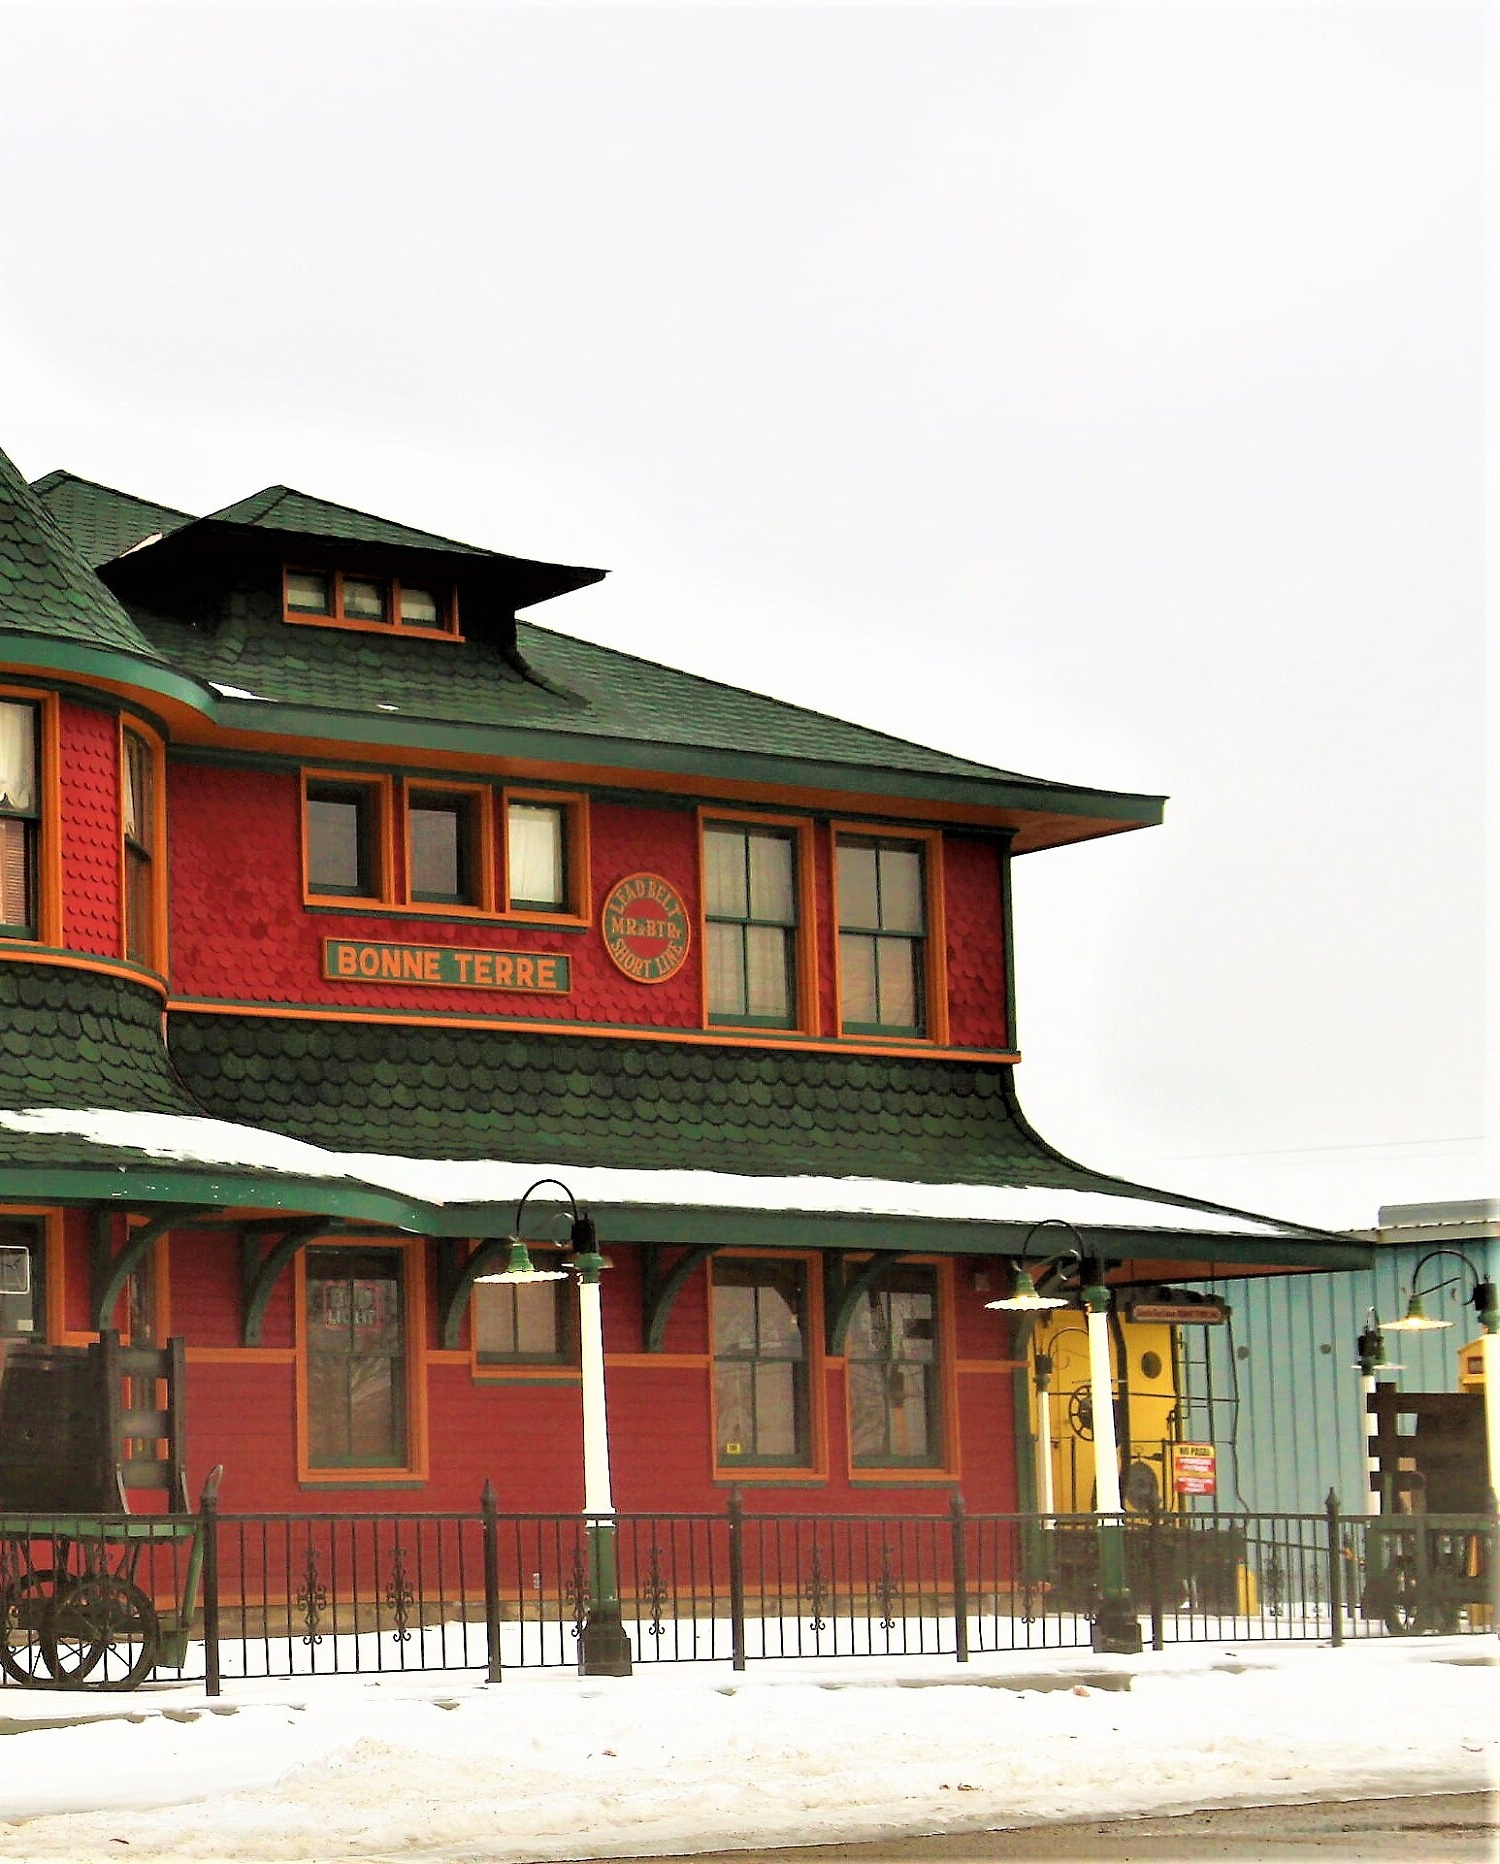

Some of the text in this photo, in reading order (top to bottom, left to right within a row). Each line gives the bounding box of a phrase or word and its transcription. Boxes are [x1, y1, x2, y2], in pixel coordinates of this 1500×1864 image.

[610, 880, 680, 918] LEAD BELT
[338, 945, 557, 988] BONNE TERRE
[610, 938, 683, 978] SHORT LINE
